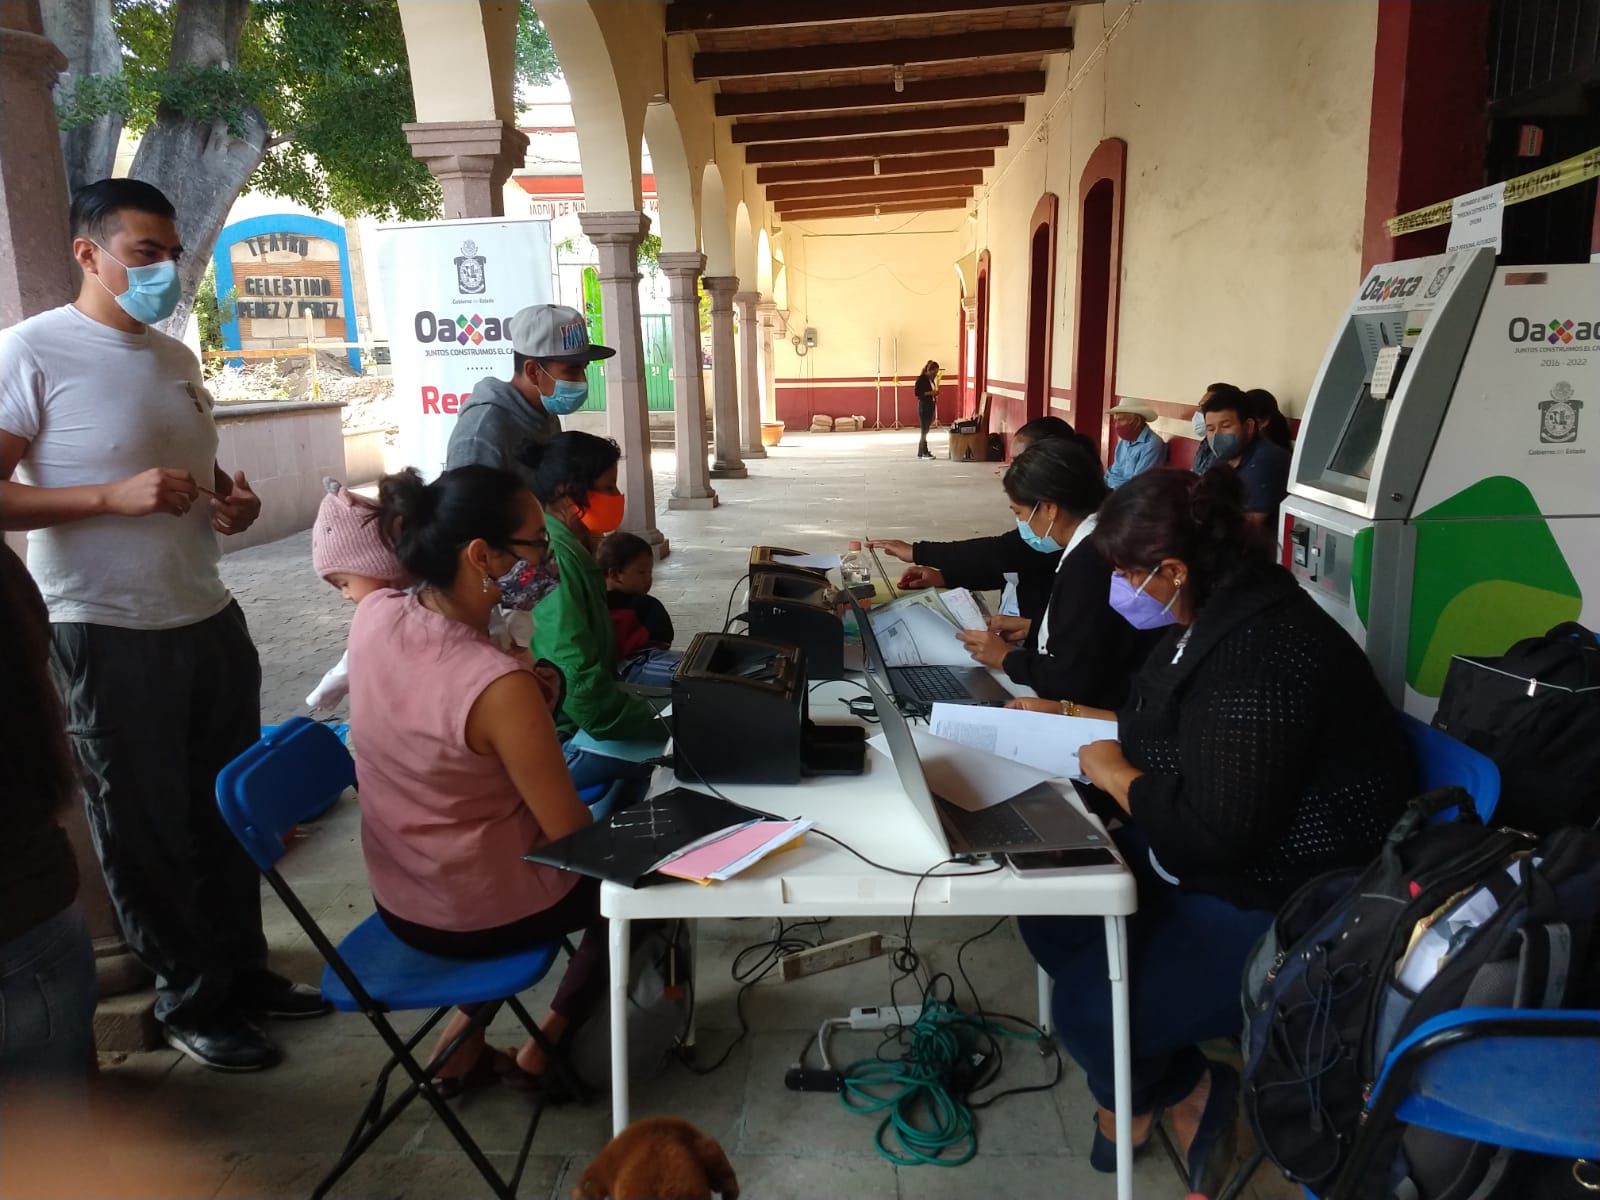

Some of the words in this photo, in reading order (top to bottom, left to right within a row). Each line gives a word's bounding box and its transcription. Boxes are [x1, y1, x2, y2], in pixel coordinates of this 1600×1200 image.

[559, 202, 569, 216] DE
[245, 232, 308, 256] TEATRO
[244, 277, 330, 296] CELESTINO
[1360, 275, 1423, 303] Oaxaca
[237, 301, 281, 318] PEREZ
[283, 301, 294, 318] Y
[298, 301, 340, 318] PEREZ
[425, 348, 450, 357] JUNTOS
[450, 348, 497, 356] CONSTRUIMOS
